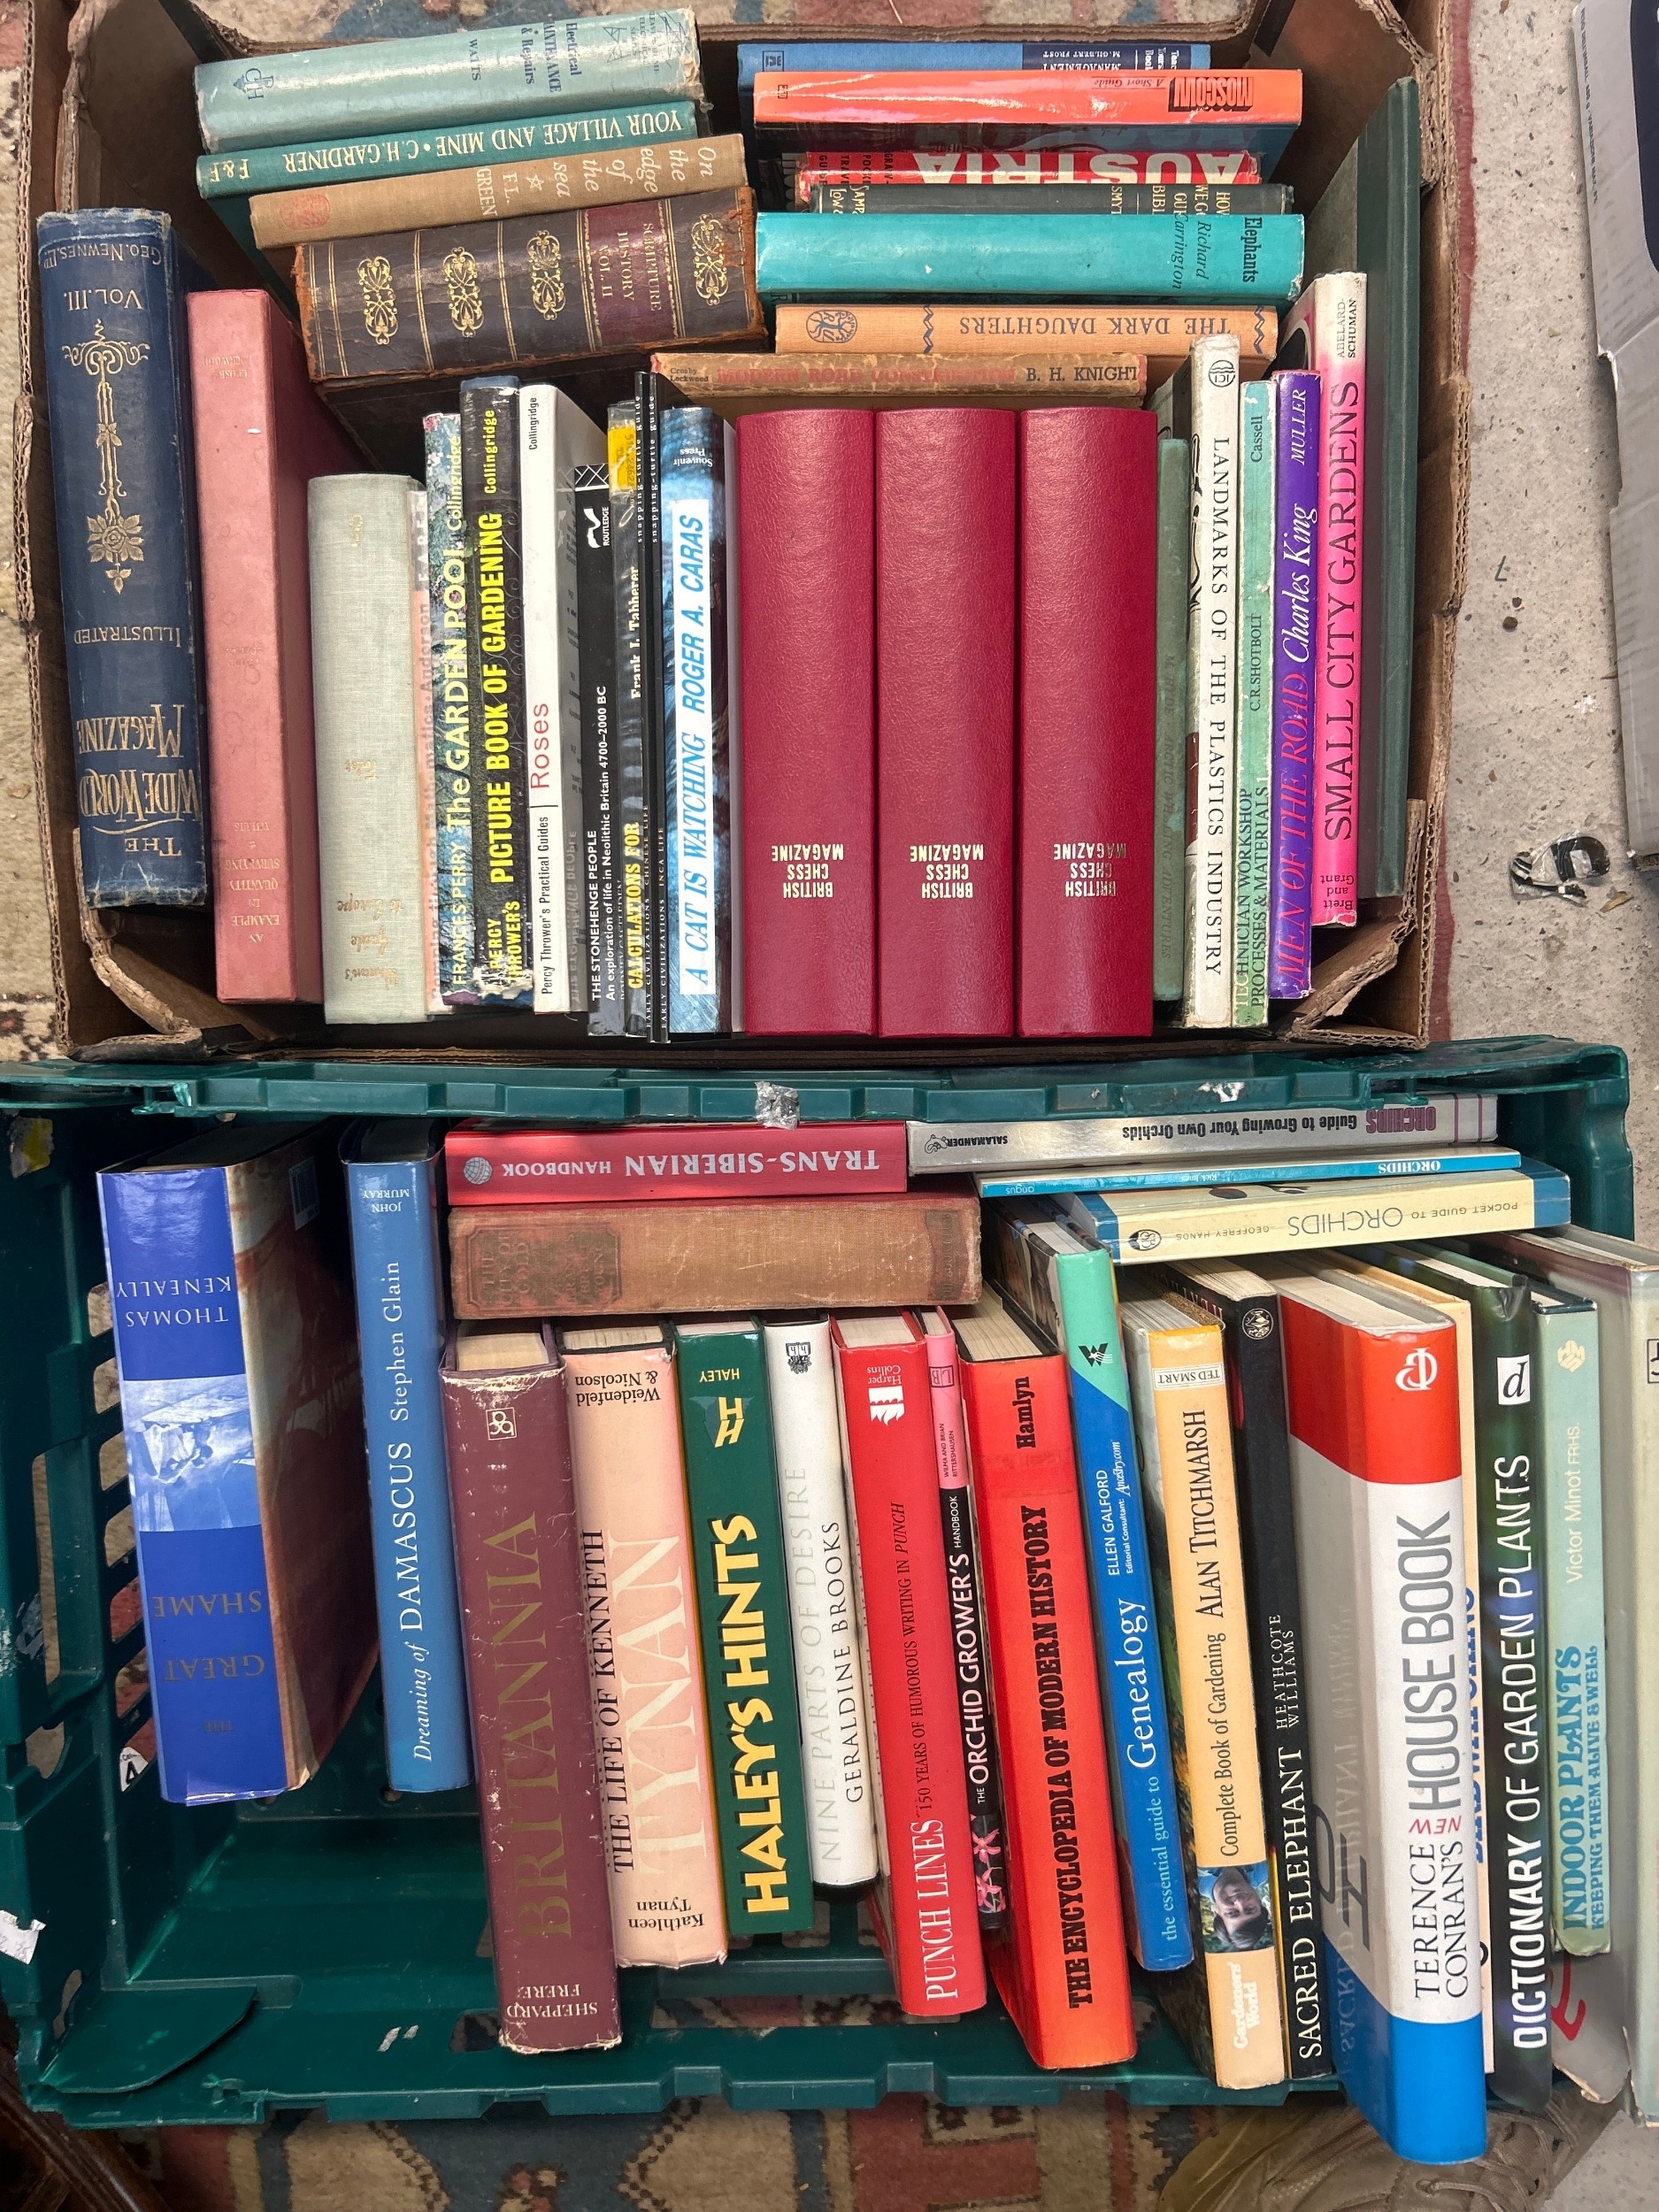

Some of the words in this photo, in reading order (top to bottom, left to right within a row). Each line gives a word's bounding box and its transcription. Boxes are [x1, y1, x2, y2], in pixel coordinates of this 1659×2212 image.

[1169, 77, 1254, 111] MOSCOW
[491, 126, 535, 150] AND
[626, 110, 682, 136] YOUR
[553, 161, 571, 198] sea
[605, 159, 633, 184] of
[636, 148, 659, 193] edge
[669, 149, 689, 181] the
[912, 152, 1246, 184] AUSTRIA
[617, 231, 634, 302] HISTORY
[642, 223, 662, 311] SCRIPTURE
[1171, 215, 1189, 290] Carrington
[1195, 221, 1212, 280] Richard
[1107, 317, 1171, 335] DARK
[1026, 367, 1041, 381] B.
[1048, 367, 1065, 381] H.
[1072, 366, 1140, 382] KNIGHT
[528, 397, 540, 450] Collingridge
[1249, 416, 1263, 463] Cassell
[1290, 388, 1308, 465] MULLER
[483, 410, 496, 494] Collingridge
[672, 457, 713, 468] Souvenir
[680, 448, 706, 457] Press
[447, 435, 462, 531] Collingridge
[1327, 380, 1359, 585] GARDENS
[1210, 438, 1230, 595] LANDMARKS
[1282, 567, 1311, 664] Charles
[74, 626, 182, 649] ILLUSTRATED
[483, 664, 508, 694] OF
[681, 631, 705, 714] ROGER
[1210, 656, 1226, 705] THE
[596, 686, 607, 705] BC
[1281, 672, 1310, 767] ROAD
[531, 703, 550, 790] Roses
[1324, 699, 1355, 841] SMALL
[446, 778, 472, 832] The
[599, 771, 611, 811] Britain
[125, 837, 182, 856] THE
[486, 781, 514, 883] PICTURE
[536, 816, 549, 850] Guides
[601, 812, 612, 866] Neolithic
[624, 822, 641, 857] FOR
[771, 843, 844, 861] MAGAZINE
[1053, 842, 1126, 860] MAGAZINE
[1239, 787, 1254, 890] WORKSHOP
[1253, 785, 1270, 893] MATERIALS
[588, 830, 598, 879] PEOPLE
[787, 864, 830, 879] CHESS
[910, 844, 984, 863] MAGAZINE
[926, 864, 970, 879] CHESS
[1070, 863, 1112, 879] CHESS
[1279, 844, 1307, 889] OF
[537, 856, 551, 904] Practical
[603, 869, 612, 880] in
[603, 882, 613, 900] life
[683, 869, 709, 898] IS
[783, 881, 833, 898] BRITISH
[1319, 873, 1355, 885] Grant
[1326, 886, 1348, 897] and
[231, 914, 280, 926] EXAMPLE
[603, 901, 613, 915] of
[1205, 850, 1224, 977] INDUSTRY
[1253, 895, 1266, 910] &
[1323, 898, 1354, 910] Brett
[451, 903, 468, 984] FRANCES
[488, 918, 503, 970] PERCY
[539, 910, 553, 962] Thrower's
[588, 883, 602, 972] STONEHENGE
[625, 863, 644, 989] CALCULATIONS
[684, 903, 709, 953] CAT
[603, 917, 618, 981] exploration
[1250, 910, 1267, 1009] PROCESSES
[541, 965, 555, 995] Percy
[592, 975, 603, 1002] THE
[606, 985, 616, 1002] An
[1122, 1124, 1174, 1140] Orchids
[1176, 1122, 1207, 1139] Own
[1210, 1121, 1240, 1137] Your
[1301, 1116, 1317, 1131] to
[1322, 1114, 1357, 1130] Guide
[1366, 1105, 1438, 1134] ORCHIDS
[947, 1135, 1009, 1148] SALAMANDER
[625, 1149, 880, 1178] TRANS-SIBERIAN
[1378, 1160, 1441, 1174] ORCHIDS
[362, 1188, 411, 1200] MURRAY
[372, 1202, 403, 1213] JOHN
[1005, 1186, 1035, 1195] angus
[1472, 1202, 1518, 1214] POCKET
[1216, 1225, 1270, 1237] GEOFFREY
[1286, 1206, 1404, 1237] ORCHIDS
[1411, 1210, 1427, 1220] TO
[1431, 1206, 1469, 1217] GUIDE
[1175, 1231, 1211, 1240] HANDS
[115, 1276, 233, 1299] KENEALLY
[384, 1331, 413, 1422] Stephen
[575, 1372, 642, 1387] Nicolson
[647, 1371, 659, 1384] &
[699, 1368, 741, 1382] HALEY
[866, 1364, 902, 1375] Collins
[866, 1376, 902, 1386] Harper
[1157, 1371, 1197, 1386] SMART
[1197, 1368, 1221, 1381] TED
[575, 1386, 662, 1407] Weidenfeld
[1095, 1469, 1115, 1532] GALFORD
[1182, 1409, 1219, 1555] TITCHMARSH
[1563, 1467, 1583, 1524] Minot
[784, 1467, 818, 1588] DESIRE
[889, 1501, 910, 1555] PUNCH
[949, 1495, 963, 1548] HANDBOOK
[896, 1559, 910, 1574] IN
[1124, 1545, 1135, 1575] Editorial
[1565, 1528, 1585, 1585] Victor
[821, 1520, 849, 1634] BROOKS
[1395, 1510, 1455, 1646] BOOK
[153, 1590, 264, 1619] SHAME
[581, 1529, 617, 1680] KENNETH
[902, 1641, 924, 1717] HUMOROUS
[1032, 1622, 1069, 1732] MODERN
[1113, 1598, 1157, 1768] Genealogy
[1202, 1632, 1227, 1714] Gardening
[1268, 1613, 1289, 1729] HEATHCOTE
[1500, 1613, 1539, 1766] GARDEN
[1584, 1645, 1600, 1703] WELL
[408, 1669, 434, 1763] Dreaming
[606, 1528, 708, 1877] TYNAN
[483, 1511, 572, 1939] BRITANNIA
[833, 1645, 864, 1804] GERALDINE
[910, 1721, 926, 1739] OF
[962, 1688, 990, 1786] ORCHID
[600, 1735, 628, 1805] LIFE
[914, 1741, 930, 1783] YEARS
[1043, 1735, 1071, 1768] OF
[1586, 1722, 1601, 1780] ALIVE
[1148, 1775, 1160, 1793] to
[1503, 1771, 1543, 1823] OF
[727, 1697, 790, 1915] HALEY'S
[813, 1776, 842, 1863] NINE
[1216, 1784, 1241, 1858] Complete
[1409, 1815, 1463, 1834] NEW
[1587, 1786, 1603, 1840] THEM
[910, 1817, 950, 1901] LINES
[1558, 1794, 1588, 1931] INDOOR
[1151, 1845, 1175, 1914] essential
[1590, 1849, 1606, 1932] KEEPING
[635, 1897, 692, 1914] Tynan
[1409, 1841, 1442, 2001] TERENCE
[1439, 1839, 1470, 2000] CONRAN'S
[1161, 1915, 1177, 1942] the
[521, 1984, 580, 1999] FRERE
[1064, 1957, 1094, 2009] THE
[1289, 1936, 1323, 2060] SACRED
[506, 2000, 599, 2019] SHEPPARD
